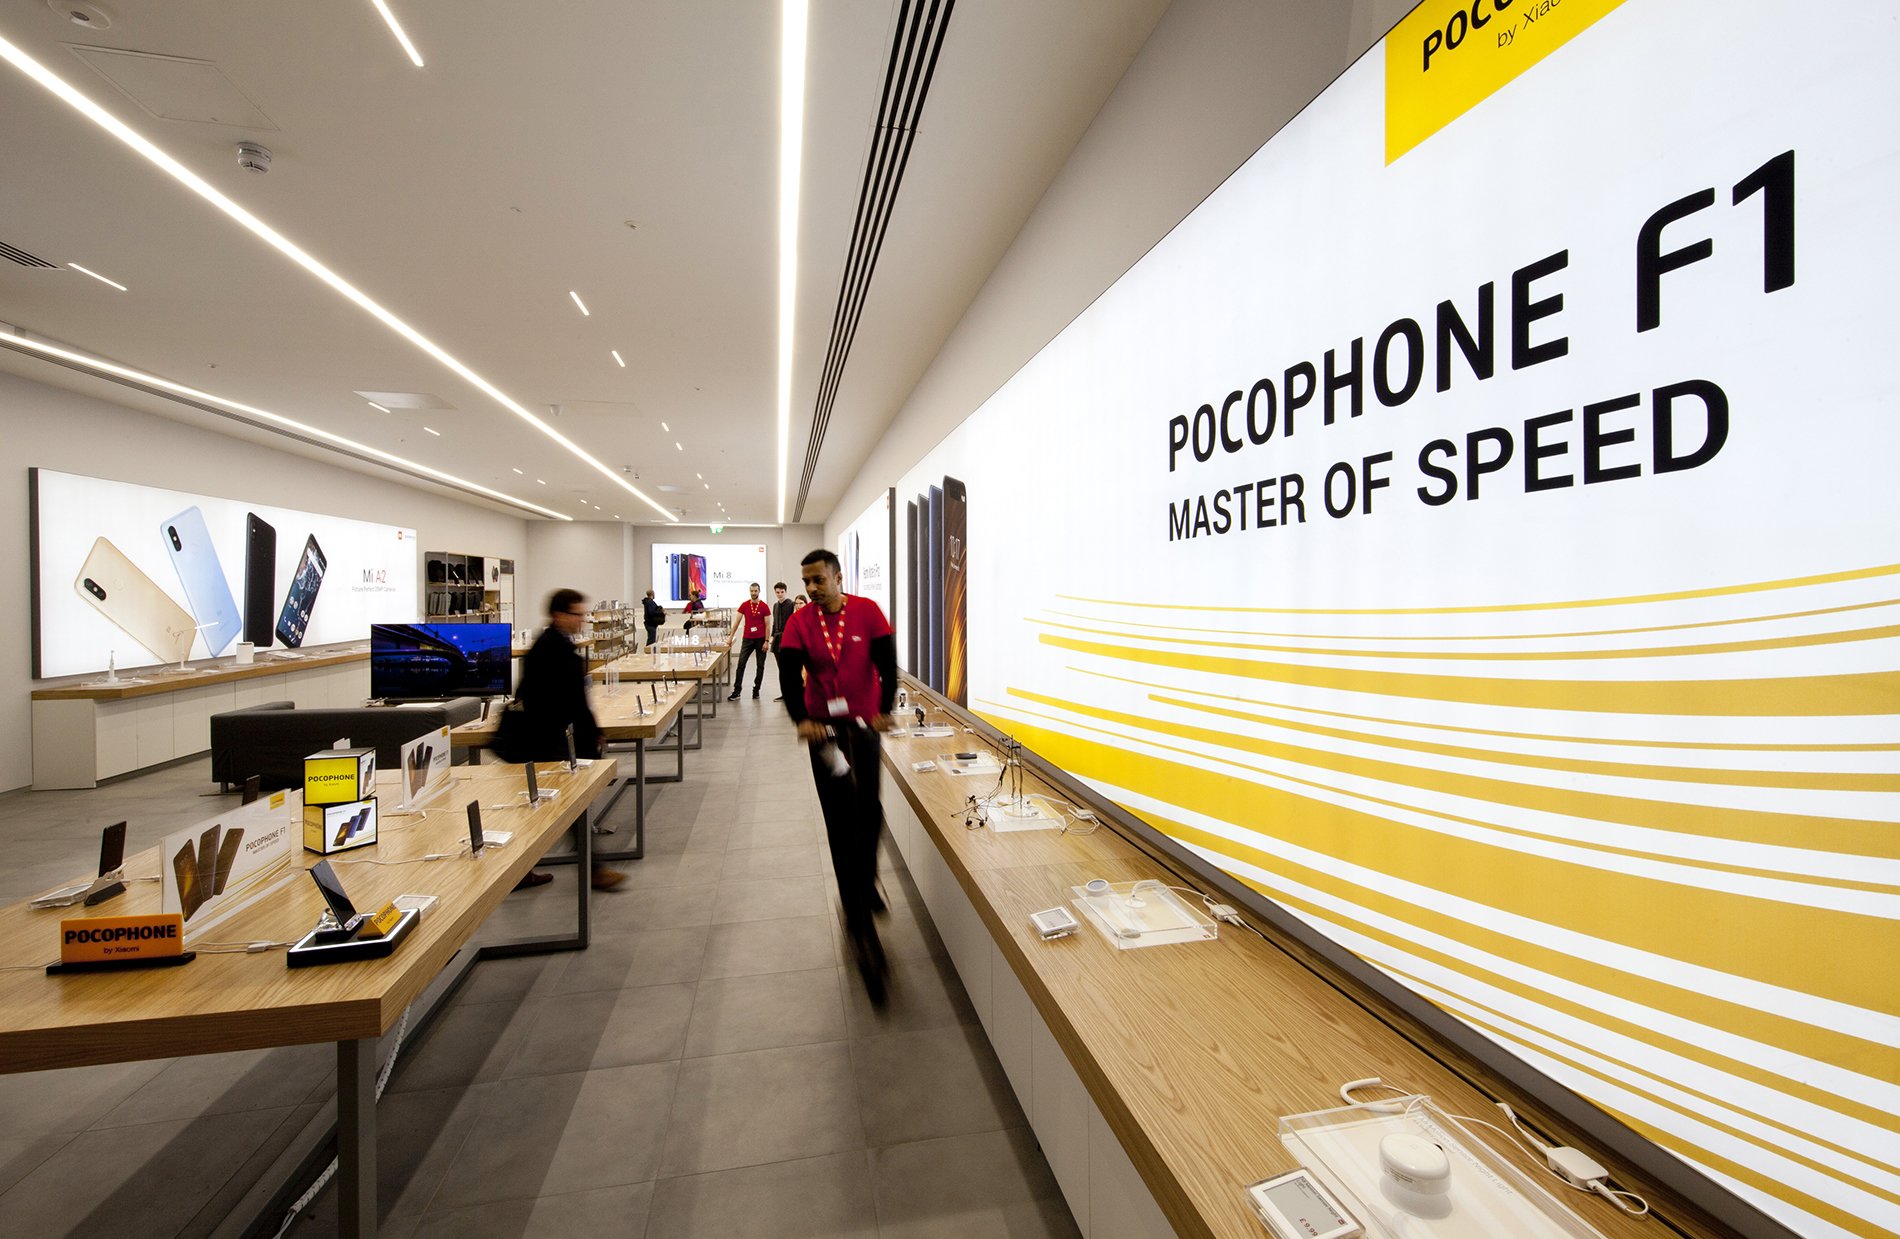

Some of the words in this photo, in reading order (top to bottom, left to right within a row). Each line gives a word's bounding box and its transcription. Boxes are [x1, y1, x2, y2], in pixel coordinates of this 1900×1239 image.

[1423, 0, 1514, 72] POC
[1497, 24, 1516, 48] by
[1169, 249, 1568, 472] POCOPHONE
[1636, 149, 1795, 333] F1
[1169, 473, 1306, 542] MASTER
[1324, 451, 1393, 519] OF
[1417, 379, 1729, 506] SPEED
[363, 568, 374, 583] Mi
[375, 569, 387, 584] A2
[713, 571, 724, 579] Mi
[726, 571, 732, 579] 8
[674, 635, 689, 646] Mi
[692, 634, 700, 646] 8
[308, 773, 355, 783] POCOPHONE
[246, 829, 279, 852] POCOPHONE
[65, 924, 177, 945] POCOPHONE
[103, 947, 113, 955] by
[114, 945, 140, 953] Xiaomi
